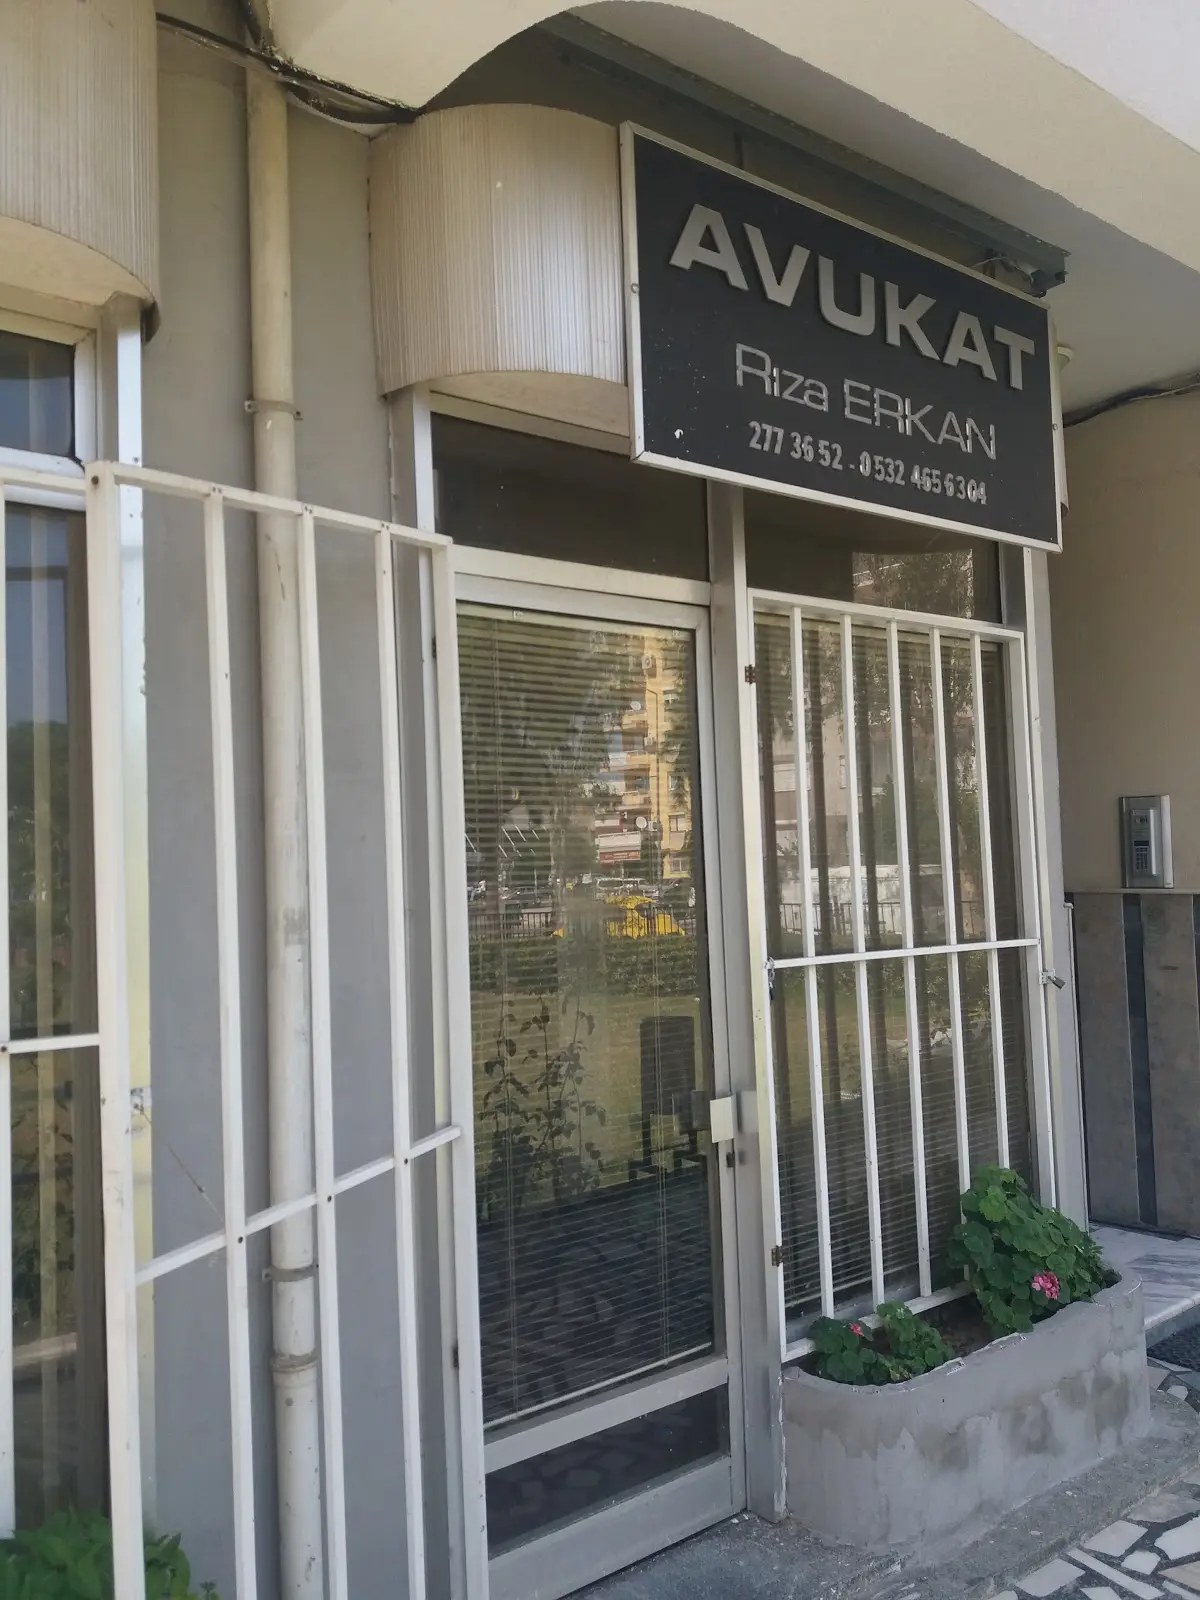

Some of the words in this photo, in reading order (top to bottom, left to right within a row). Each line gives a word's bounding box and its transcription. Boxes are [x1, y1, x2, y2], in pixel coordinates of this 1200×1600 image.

[669, 203, 1035, 391] AVUKAT
[749, 421, 784, 454] 277
[844, 378, 996, 460] ERKAN
